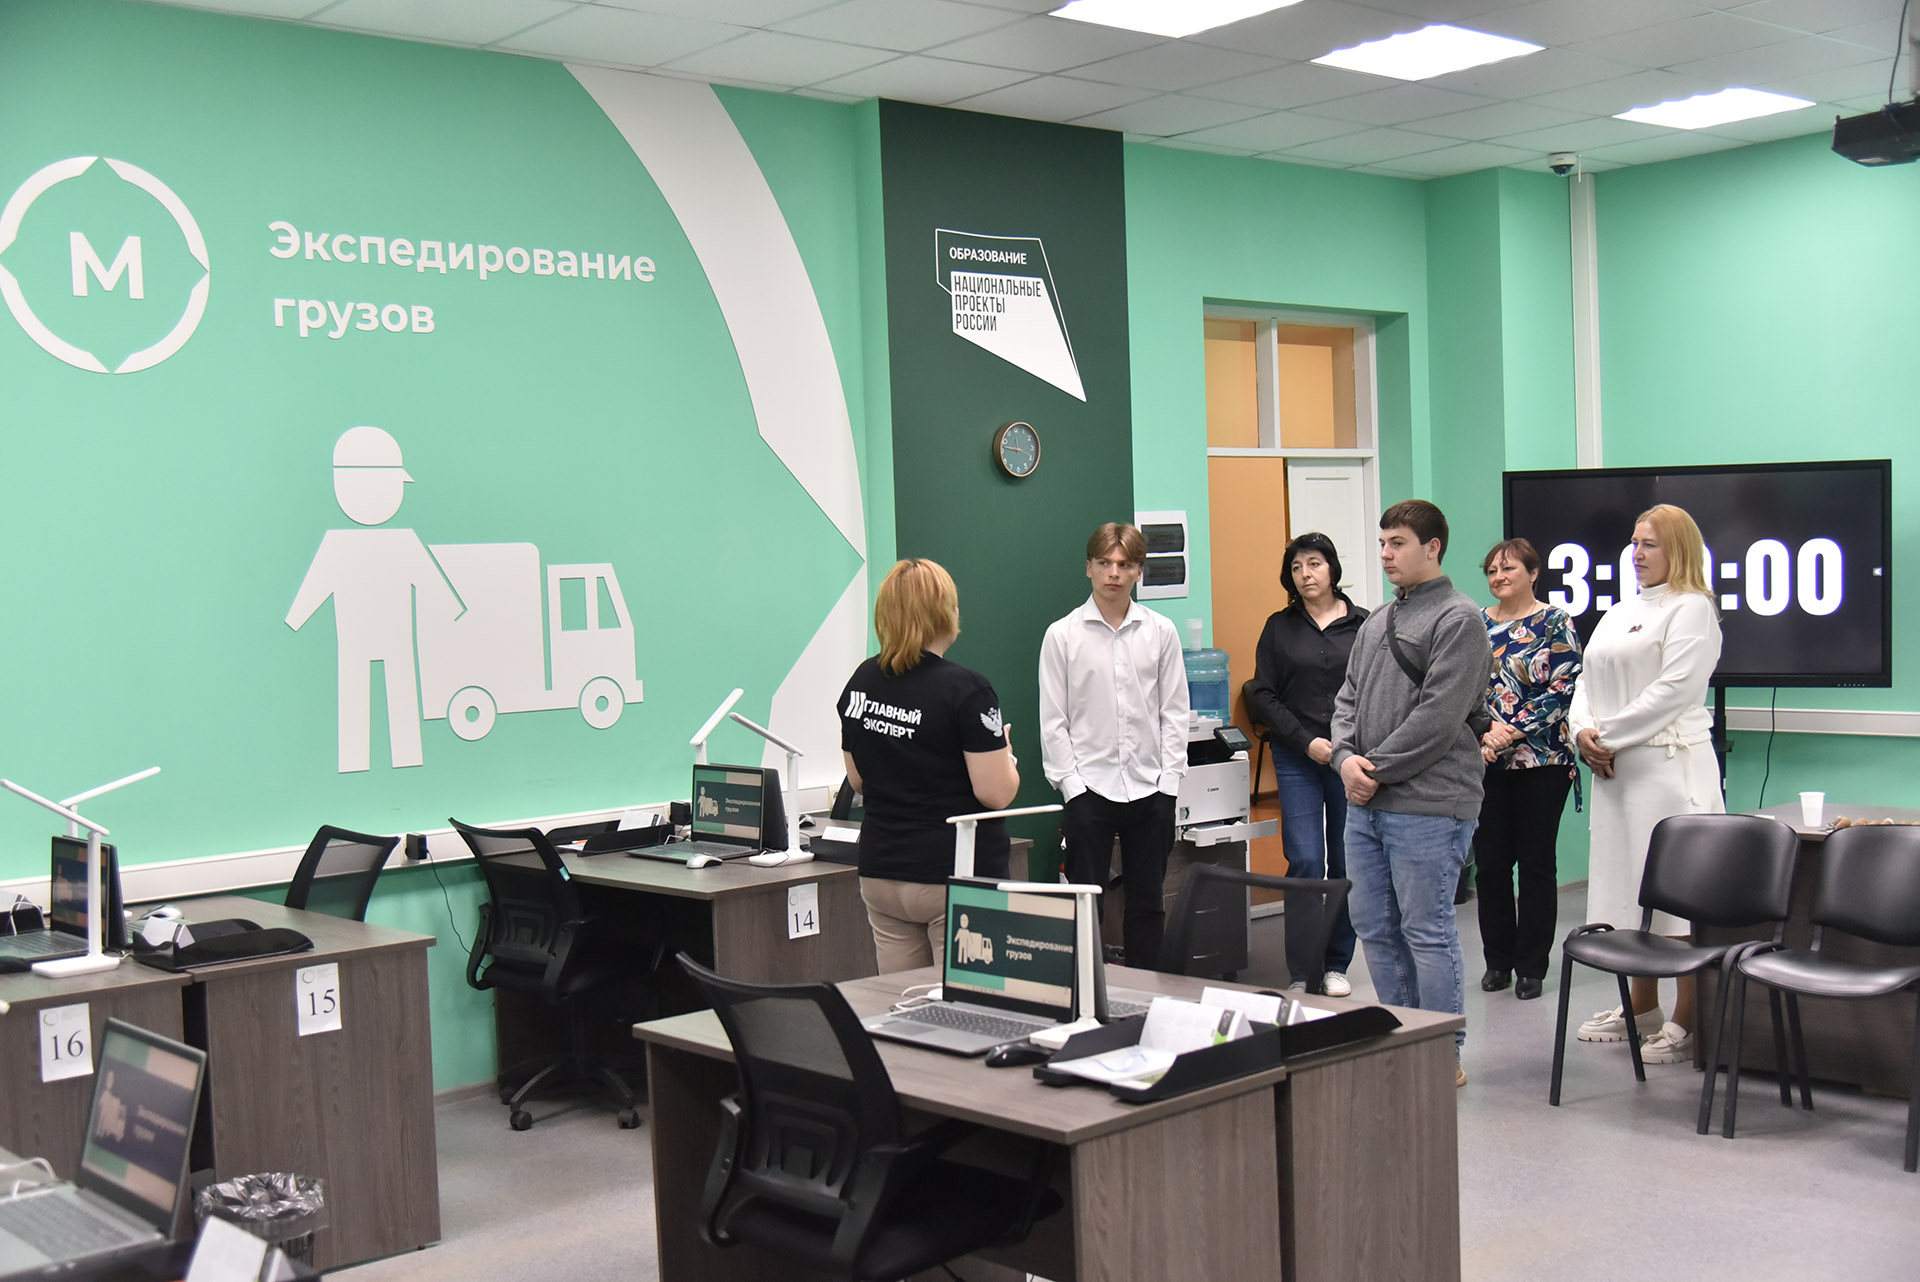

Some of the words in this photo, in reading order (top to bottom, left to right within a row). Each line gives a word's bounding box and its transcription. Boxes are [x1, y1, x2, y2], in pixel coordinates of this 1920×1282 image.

[268, 221, 656, 282] Экспедирование
[949, 247, 1028, 265] ОБРАЗОВАНИЕ
[954, 275, 1042, 298] НАЦИОНАЛЬНЫЕ
[955, 294, 1006, 314] ПРОЕКТЫ
[273, 297, 435, 340] грузов
[956, 313, 997, 332] РОССИИ
[863, 700, 922, 725] ГЛАВНЫЙ
[863, 717, 915, 740] ЭКСПЕРТ
[794, 909, 815, 934] 14
[1005, 949, 1033, 961] грузов
[308, 988, 337, 1016] 15
[51, 1029, 84, 1062] 16
